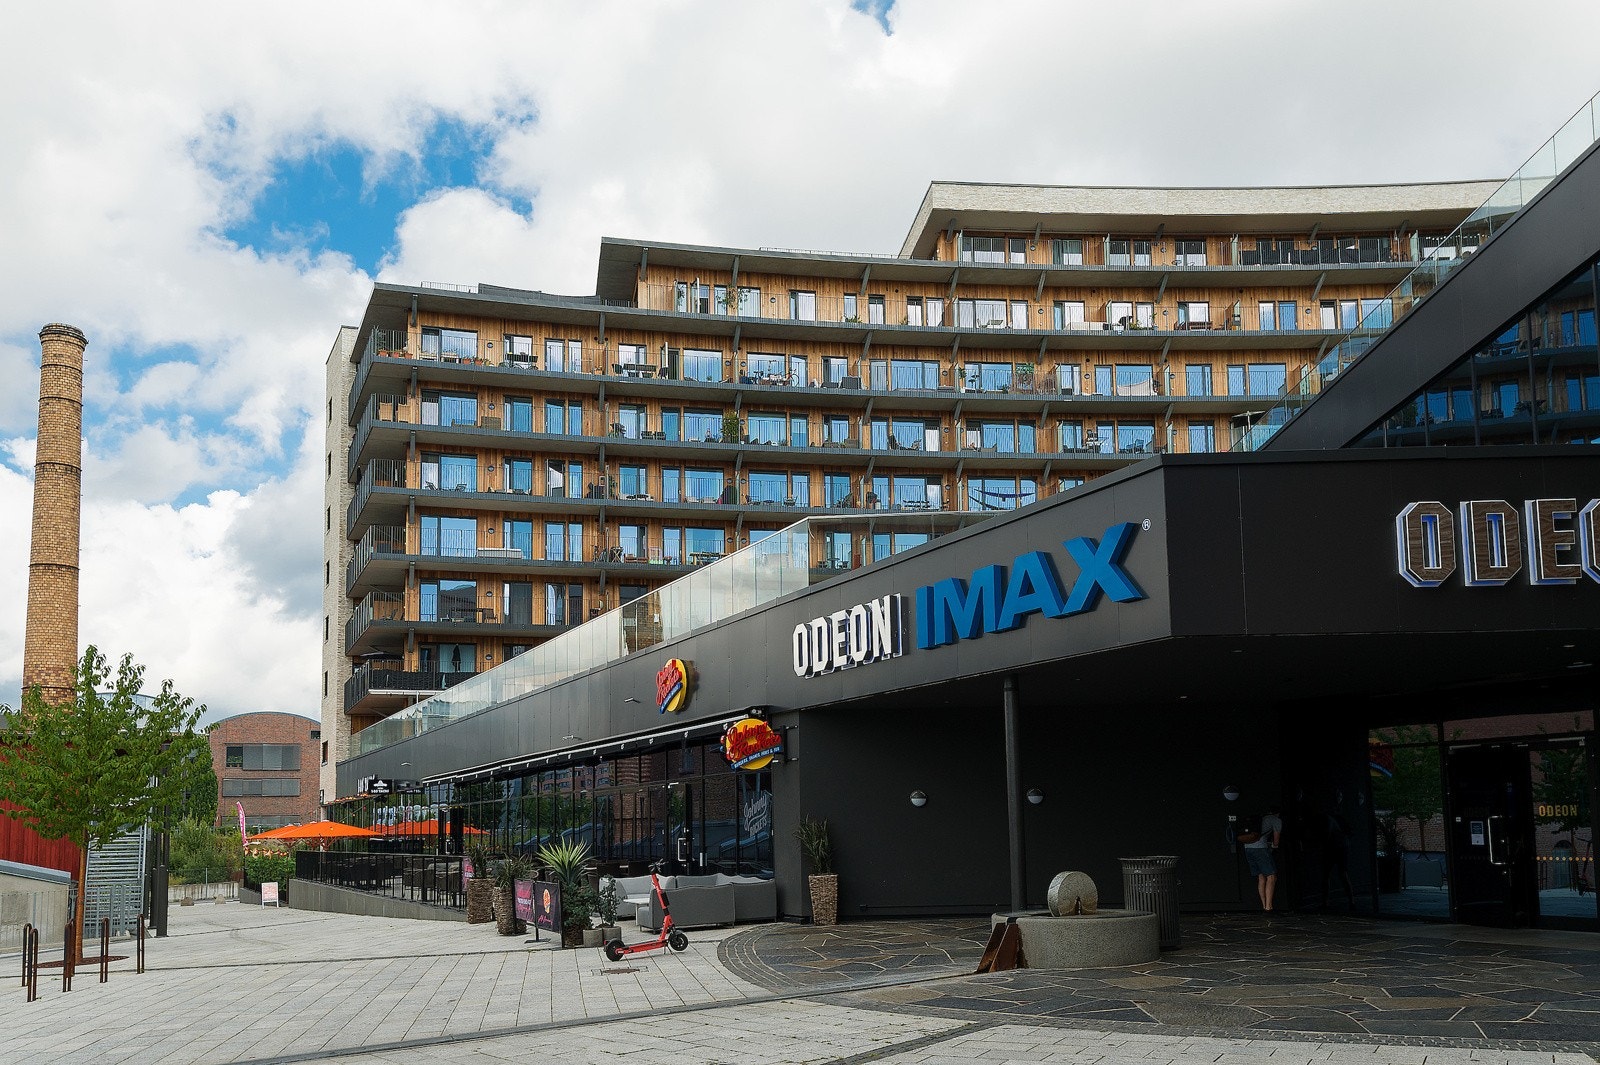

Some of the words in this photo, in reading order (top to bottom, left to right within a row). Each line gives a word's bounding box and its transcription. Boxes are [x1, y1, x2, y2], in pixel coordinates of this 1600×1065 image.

[793, 593, 904, 679] ODEON
[727, 721, 768, 754] Johnny
[731, 733, 781, 759] Rockets
[1538, 804, 1578, 817] ODEON
